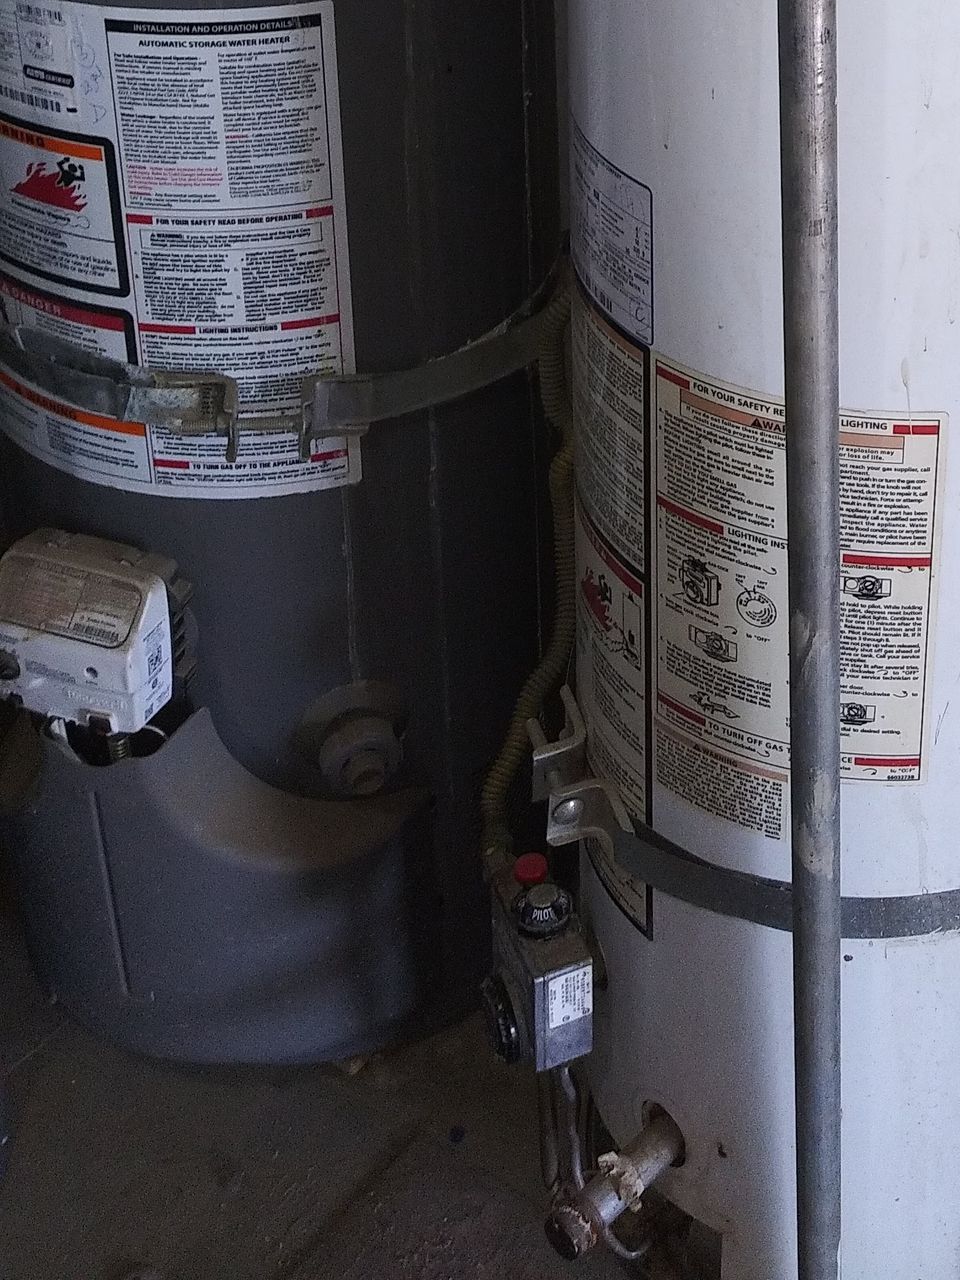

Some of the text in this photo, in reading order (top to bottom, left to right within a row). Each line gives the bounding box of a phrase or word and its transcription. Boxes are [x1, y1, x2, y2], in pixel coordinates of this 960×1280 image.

[133, 23, 190, 33] INSTALLATION
[212, 23, 258, 33] OPERATION
[260, 20, 293, 30] DETAILS
[138, 36, 290, 48] AUTOMATIC STORAGE WATER HEATER
[238, 217, 263, 225] BEFORE
[265, 213, 303, 223] OPERATING
[199, 324, 278, 334] LIGHTING INSTRUCTIONS
[693, 382, 709, 395] FOR
[711, 388, 736, 404] YOUR
[737, 398, 771, 413] SAFETY
[721, 421, 758, 435] follow these
[841, 419, 888, 430] LIGHTING
[732, 429, 758, 440] property
[727, 527, 768, 546] LIGHTING
[709, 721, 783, 753] TO TURN OFF GAS
[703, 748, 738, 768] WARNING
[532, 908, 558, 921] PILOT
